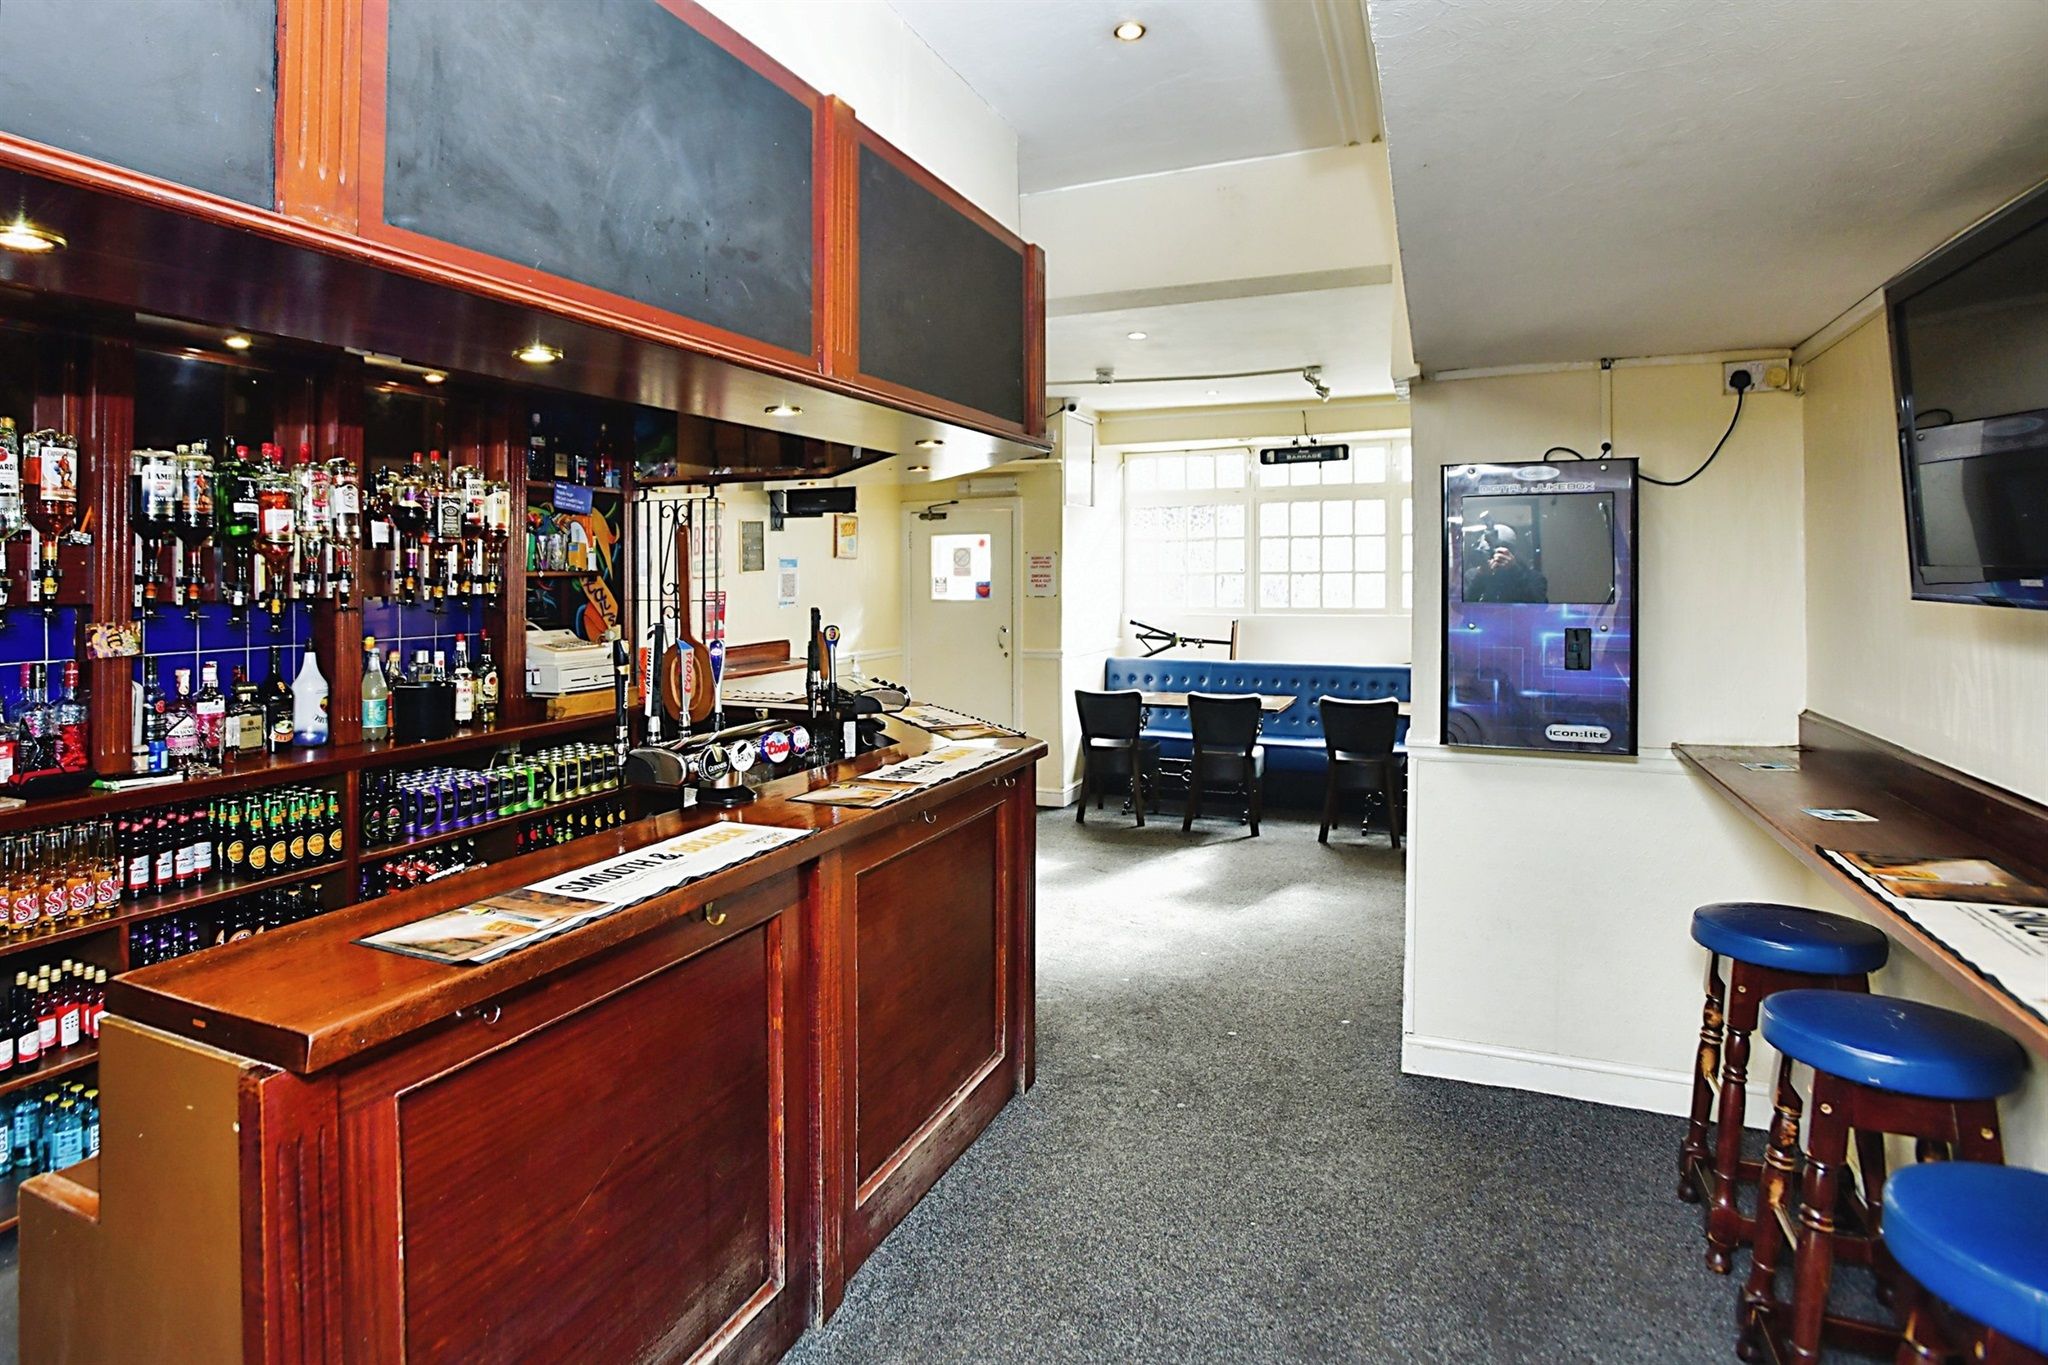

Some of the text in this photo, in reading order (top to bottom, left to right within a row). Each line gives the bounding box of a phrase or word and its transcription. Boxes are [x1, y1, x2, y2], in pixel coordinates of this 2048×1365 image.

[1478, 482, 1596, 494] DIGITAL JUKEBOX
[694, 524, 722, 556] BER
[683, 652, 693, 693] Coors
[1549, 728, 1608, 740] icon:lite
[555, 859, 654, 893] SMOOTH
[649, 853, 684, 862] &
